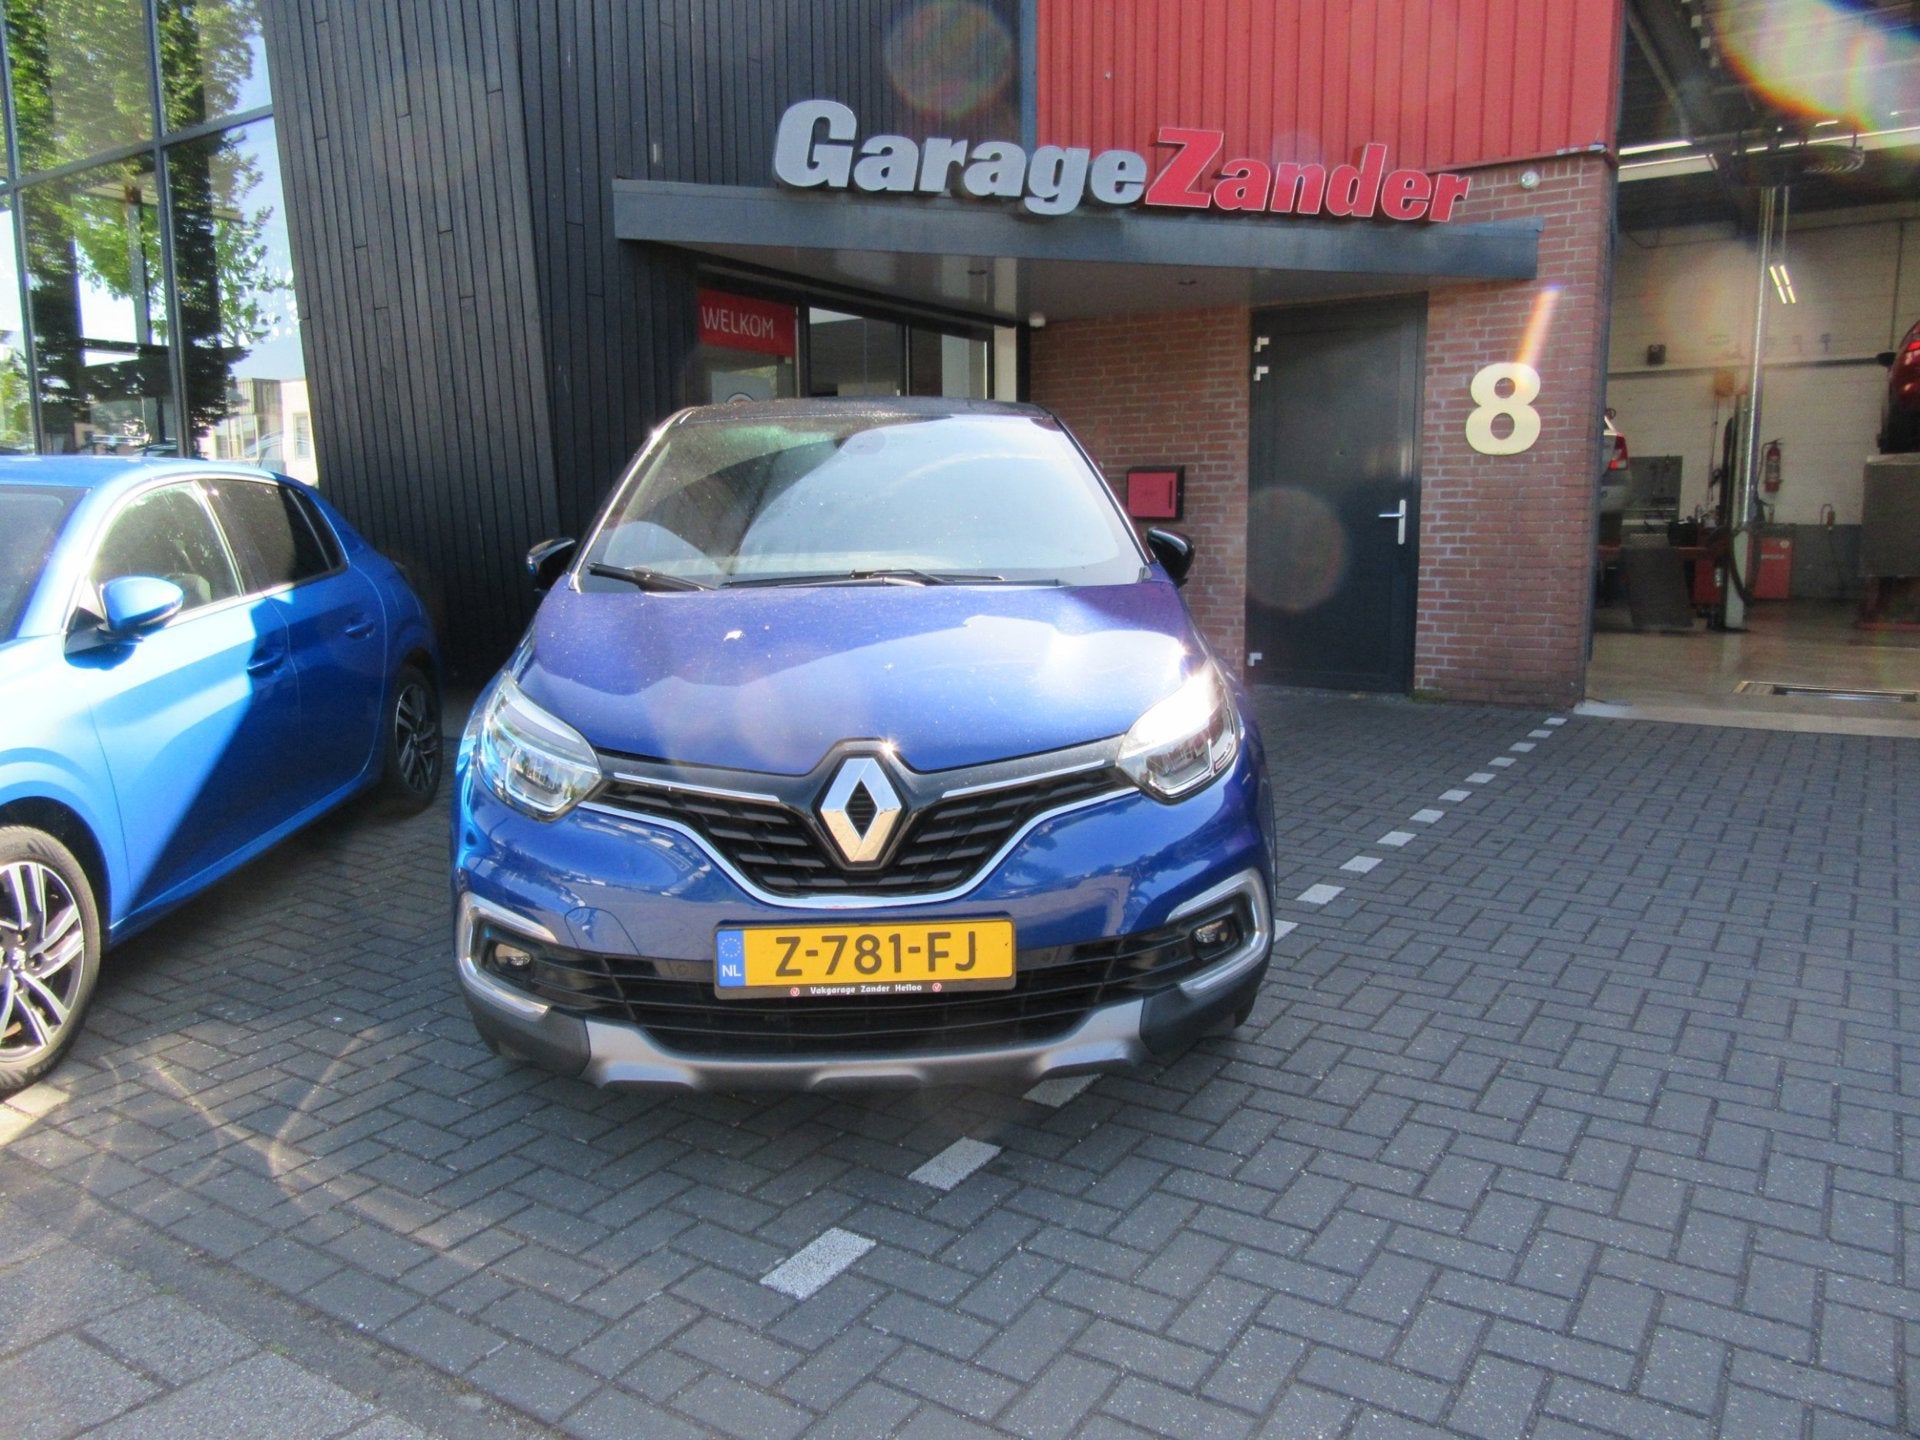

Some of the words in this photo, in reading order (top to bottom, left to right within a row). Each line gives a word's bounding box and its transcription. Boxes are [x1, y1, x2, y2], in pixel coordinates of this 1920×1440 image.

[702, 306, 775, 340] WELKOM
[1465, 362, 1541, 456] 8
[722, 964, 742, 978] NL
[775, 931, 976, 977] Z-781-FJ
[810, 986, 856, 995] Vakgarage
[860, 984, 890, 993] Zander
